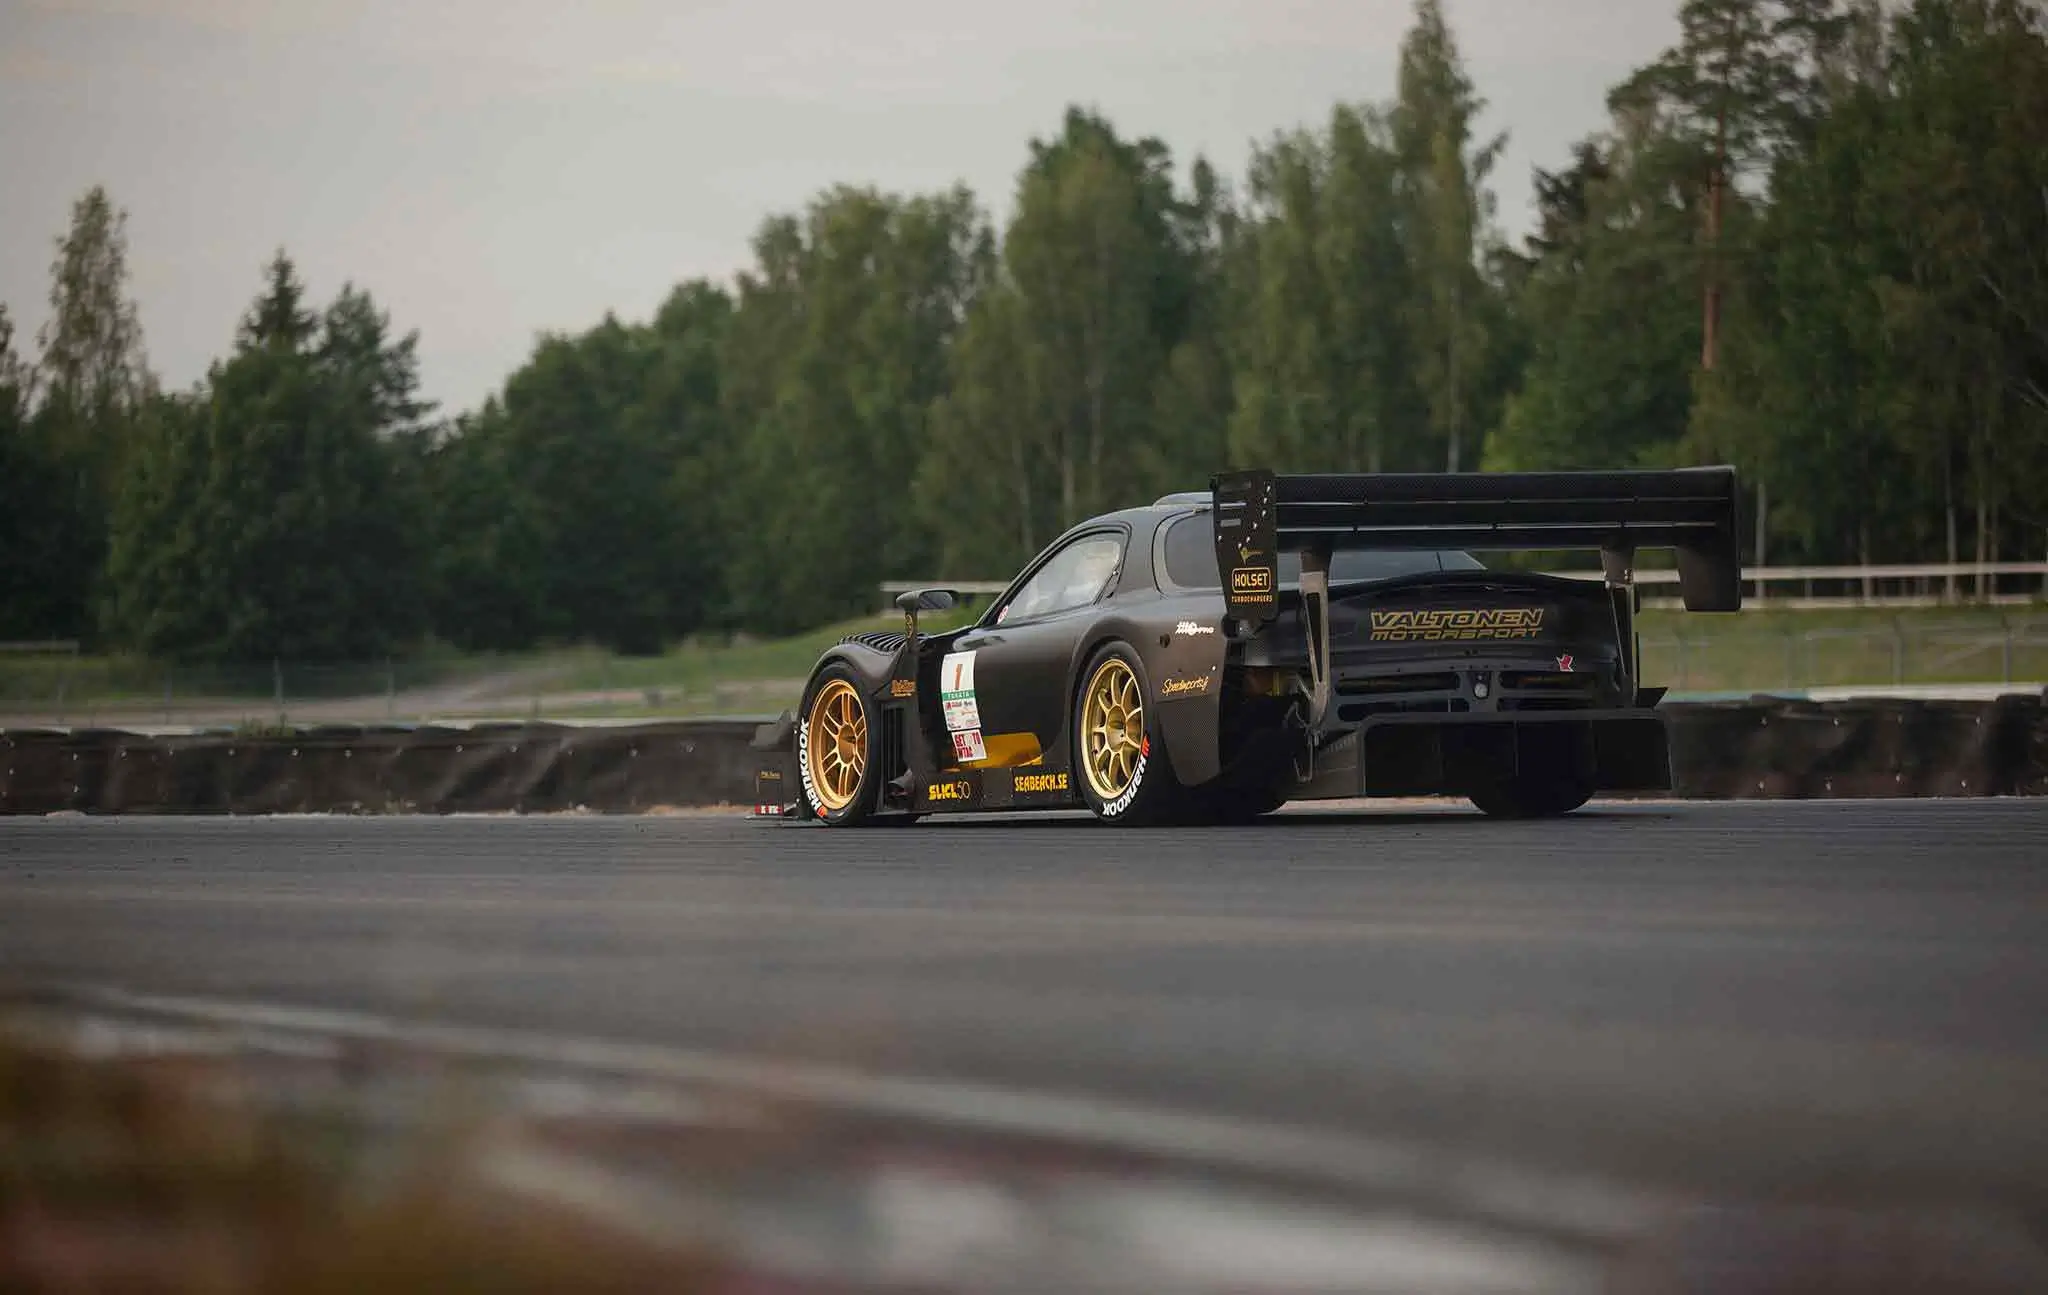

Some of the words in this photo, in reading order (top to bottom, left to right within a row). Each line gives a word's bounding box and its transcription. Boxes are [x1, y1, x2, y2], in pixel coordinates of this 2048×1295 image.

[1234, 573, 1268, 588] HOLSET
[1231, 594, 1273, 603] TURBOCHARGERS
[1371, 609, 1544, 629] VALTONEN
[1370, 628, 1543, 640] MOTORSPORT
[1014, 774, 1068, 792] SEABEACH.SE
